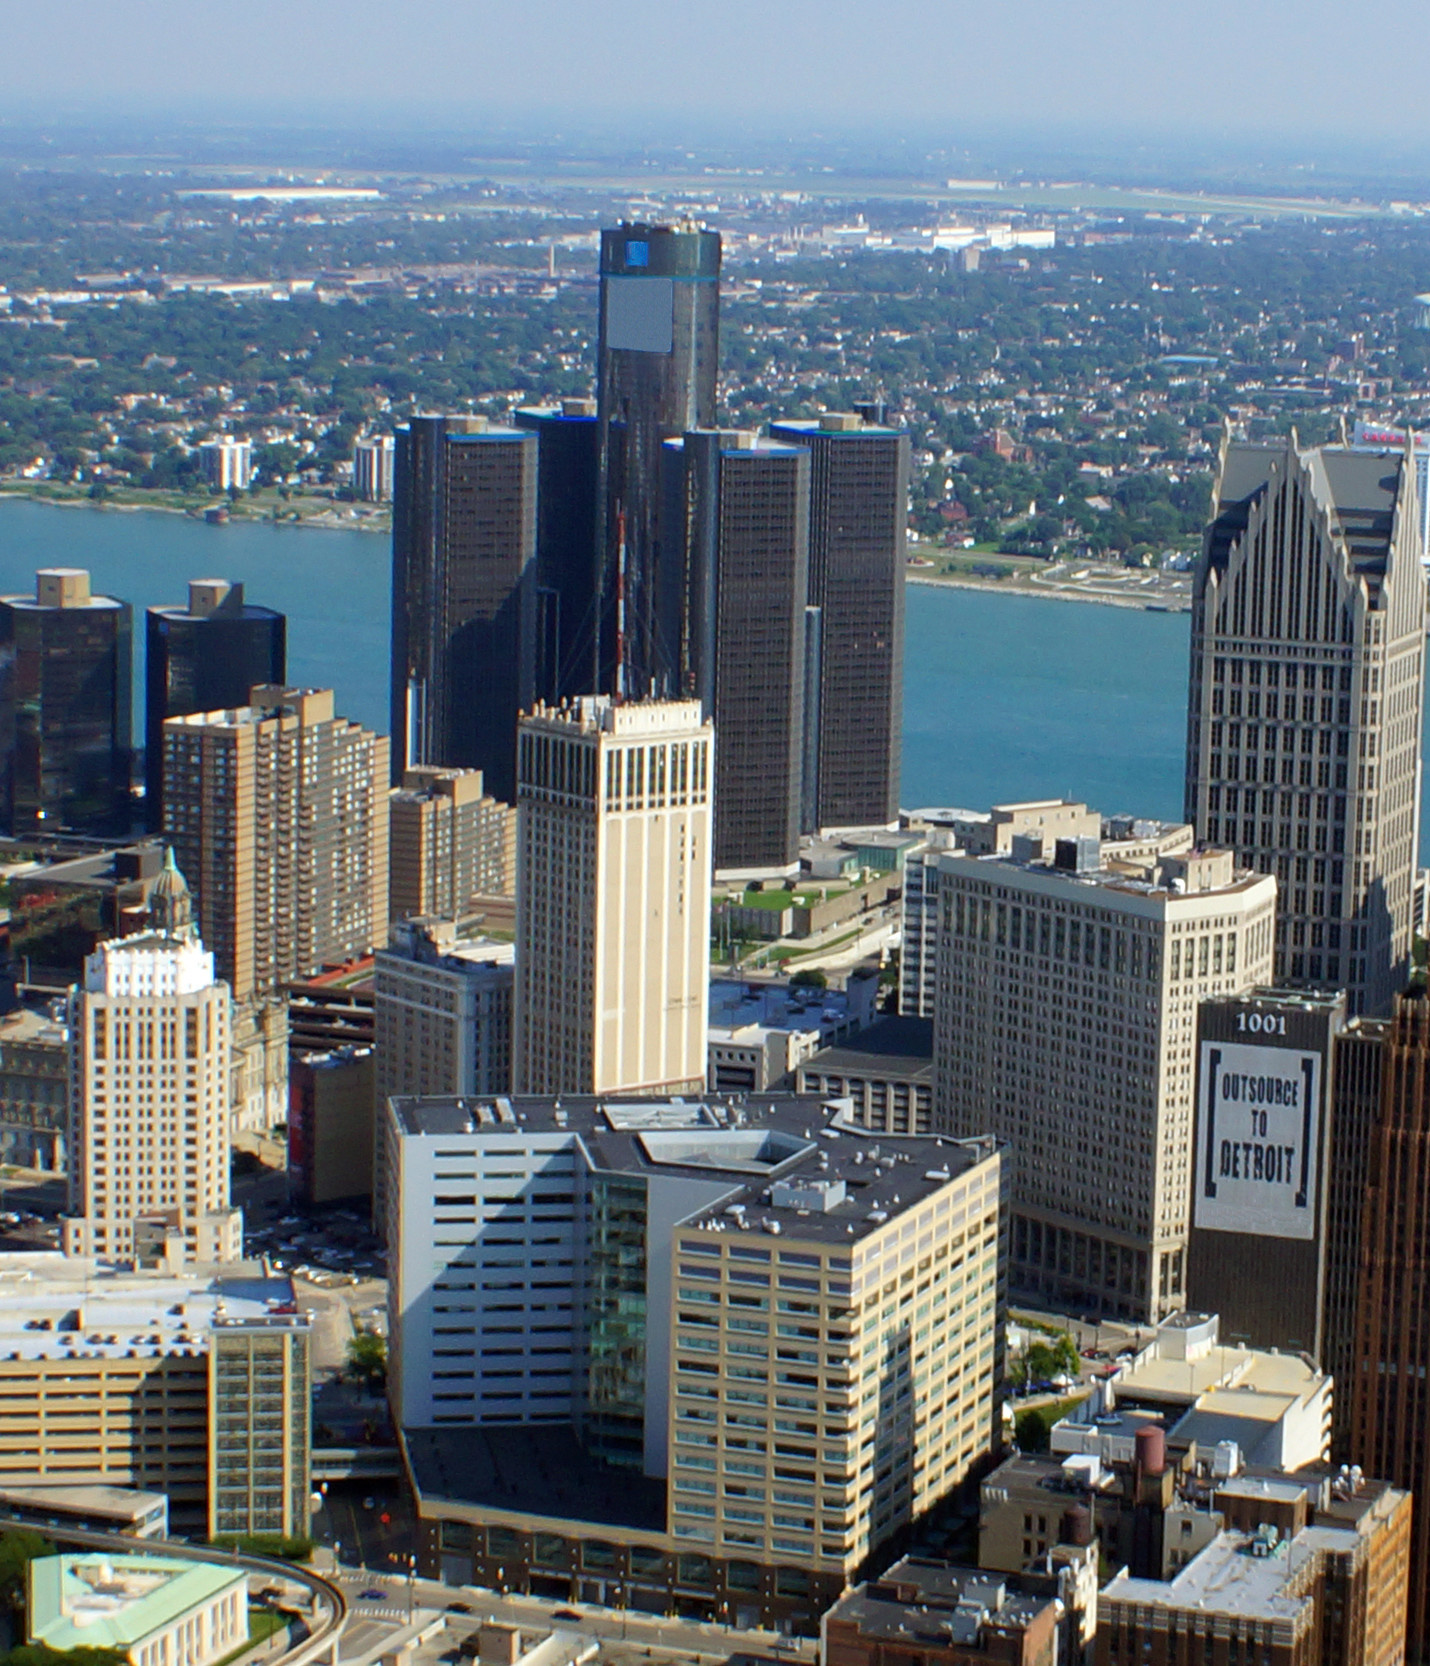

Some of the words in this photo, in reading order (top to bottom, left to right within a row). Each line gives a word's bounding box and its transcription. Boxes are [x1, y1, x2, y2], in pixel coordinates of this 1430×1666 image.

[1236, 1012, 1286, 1035] 1001
[1222, 1073, 1298, 1107] OUTSOURCE
[1251, 1109, 1267, 1138] TO
[1220, 1139, 1295, 1184] DETROIT
